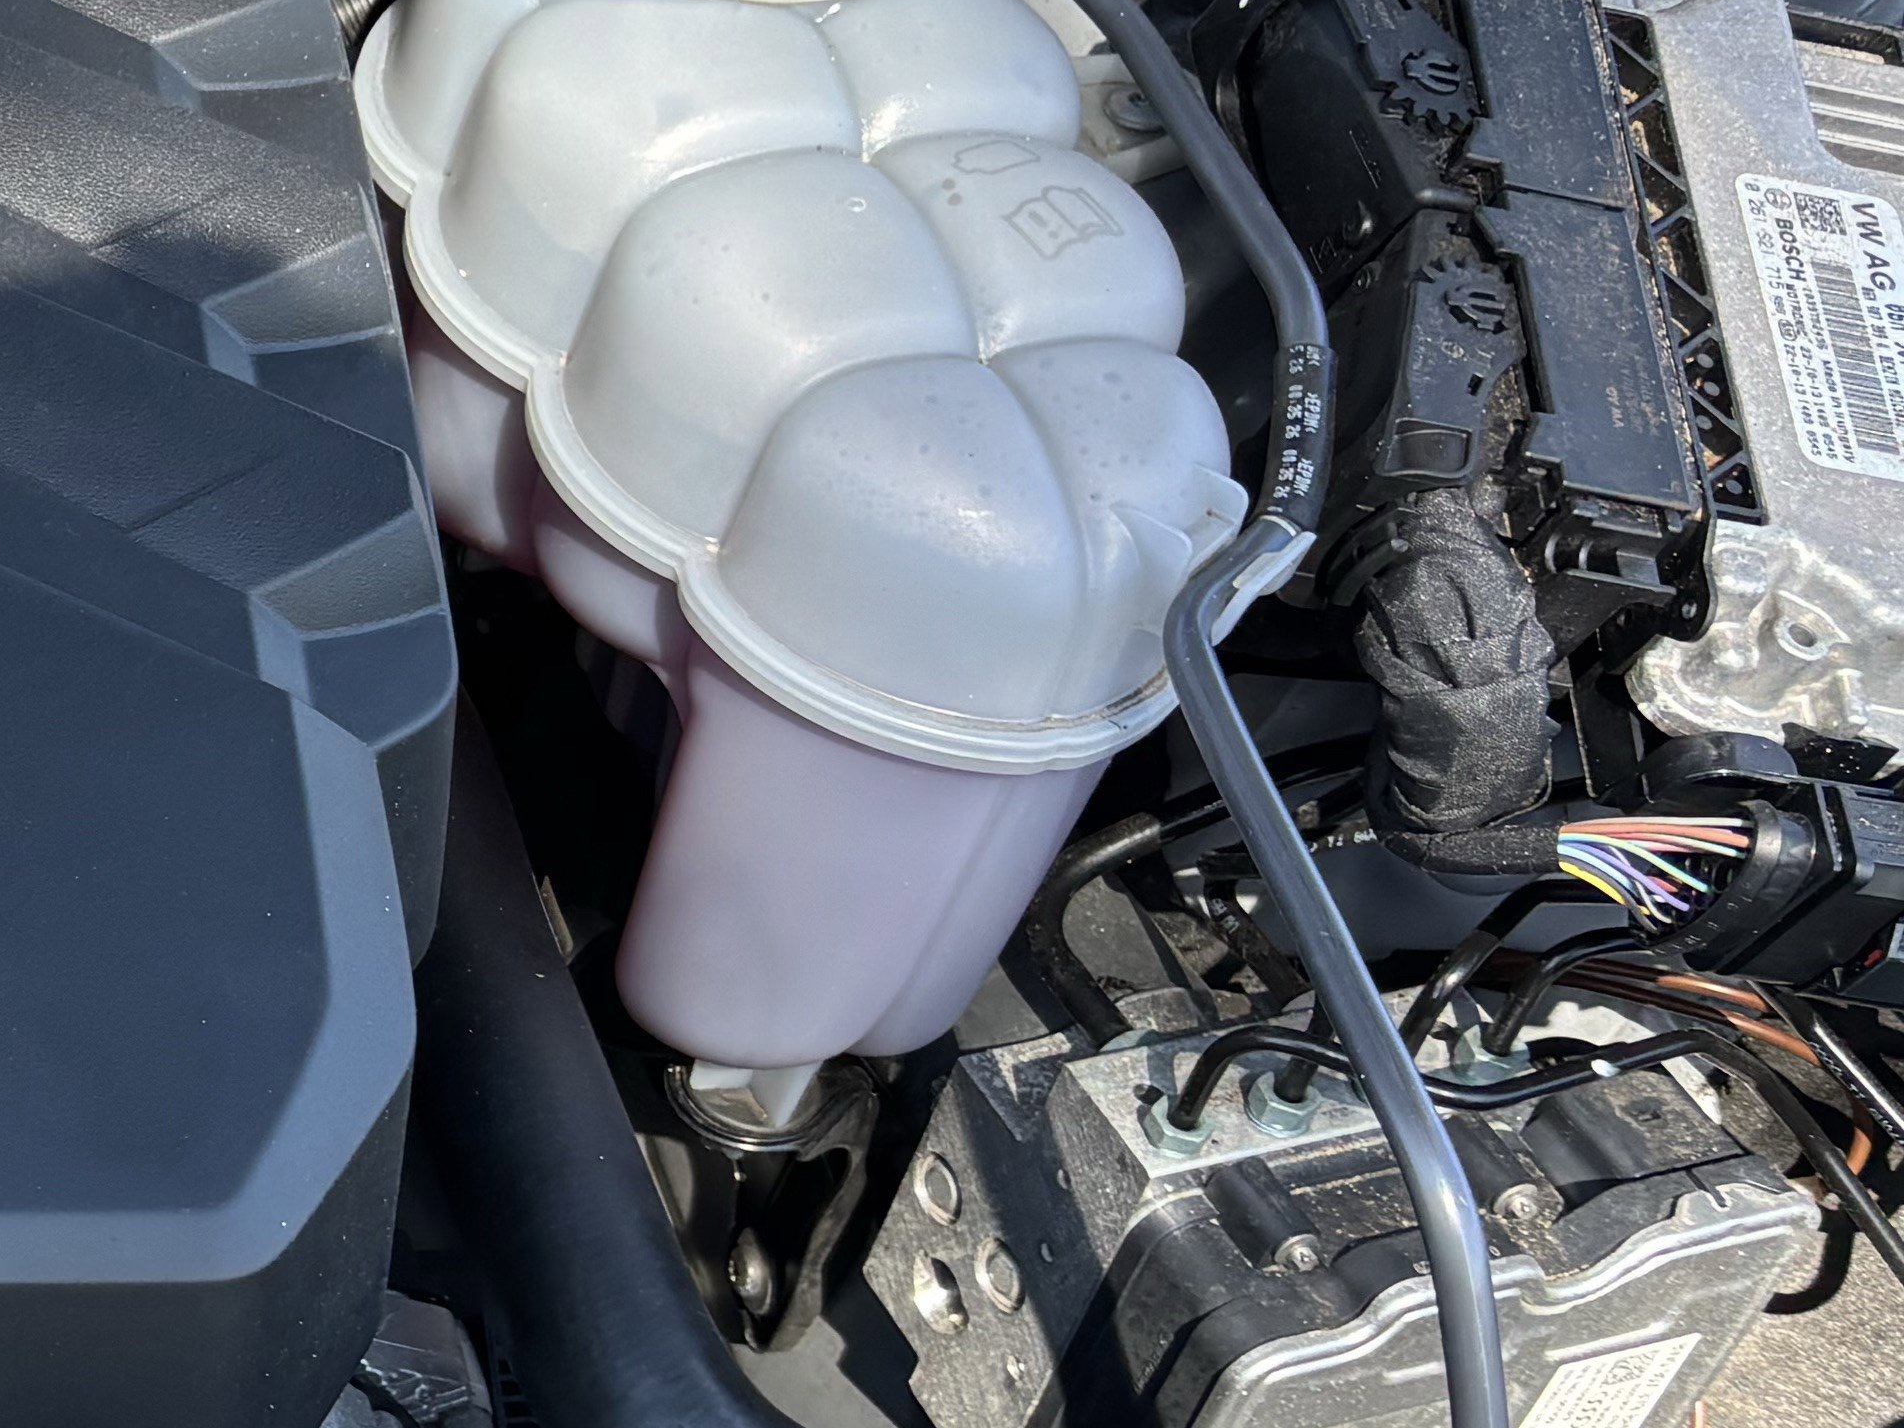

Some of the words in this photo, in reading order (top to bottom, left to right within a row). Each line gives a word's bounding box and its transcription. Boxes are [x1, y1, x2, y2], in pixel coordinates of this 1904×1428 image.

[1852, 203, 1885, 247] VW
[1775, 218, 1807, 282] BOSCH
[1863, 250, 1896, 291] AG
